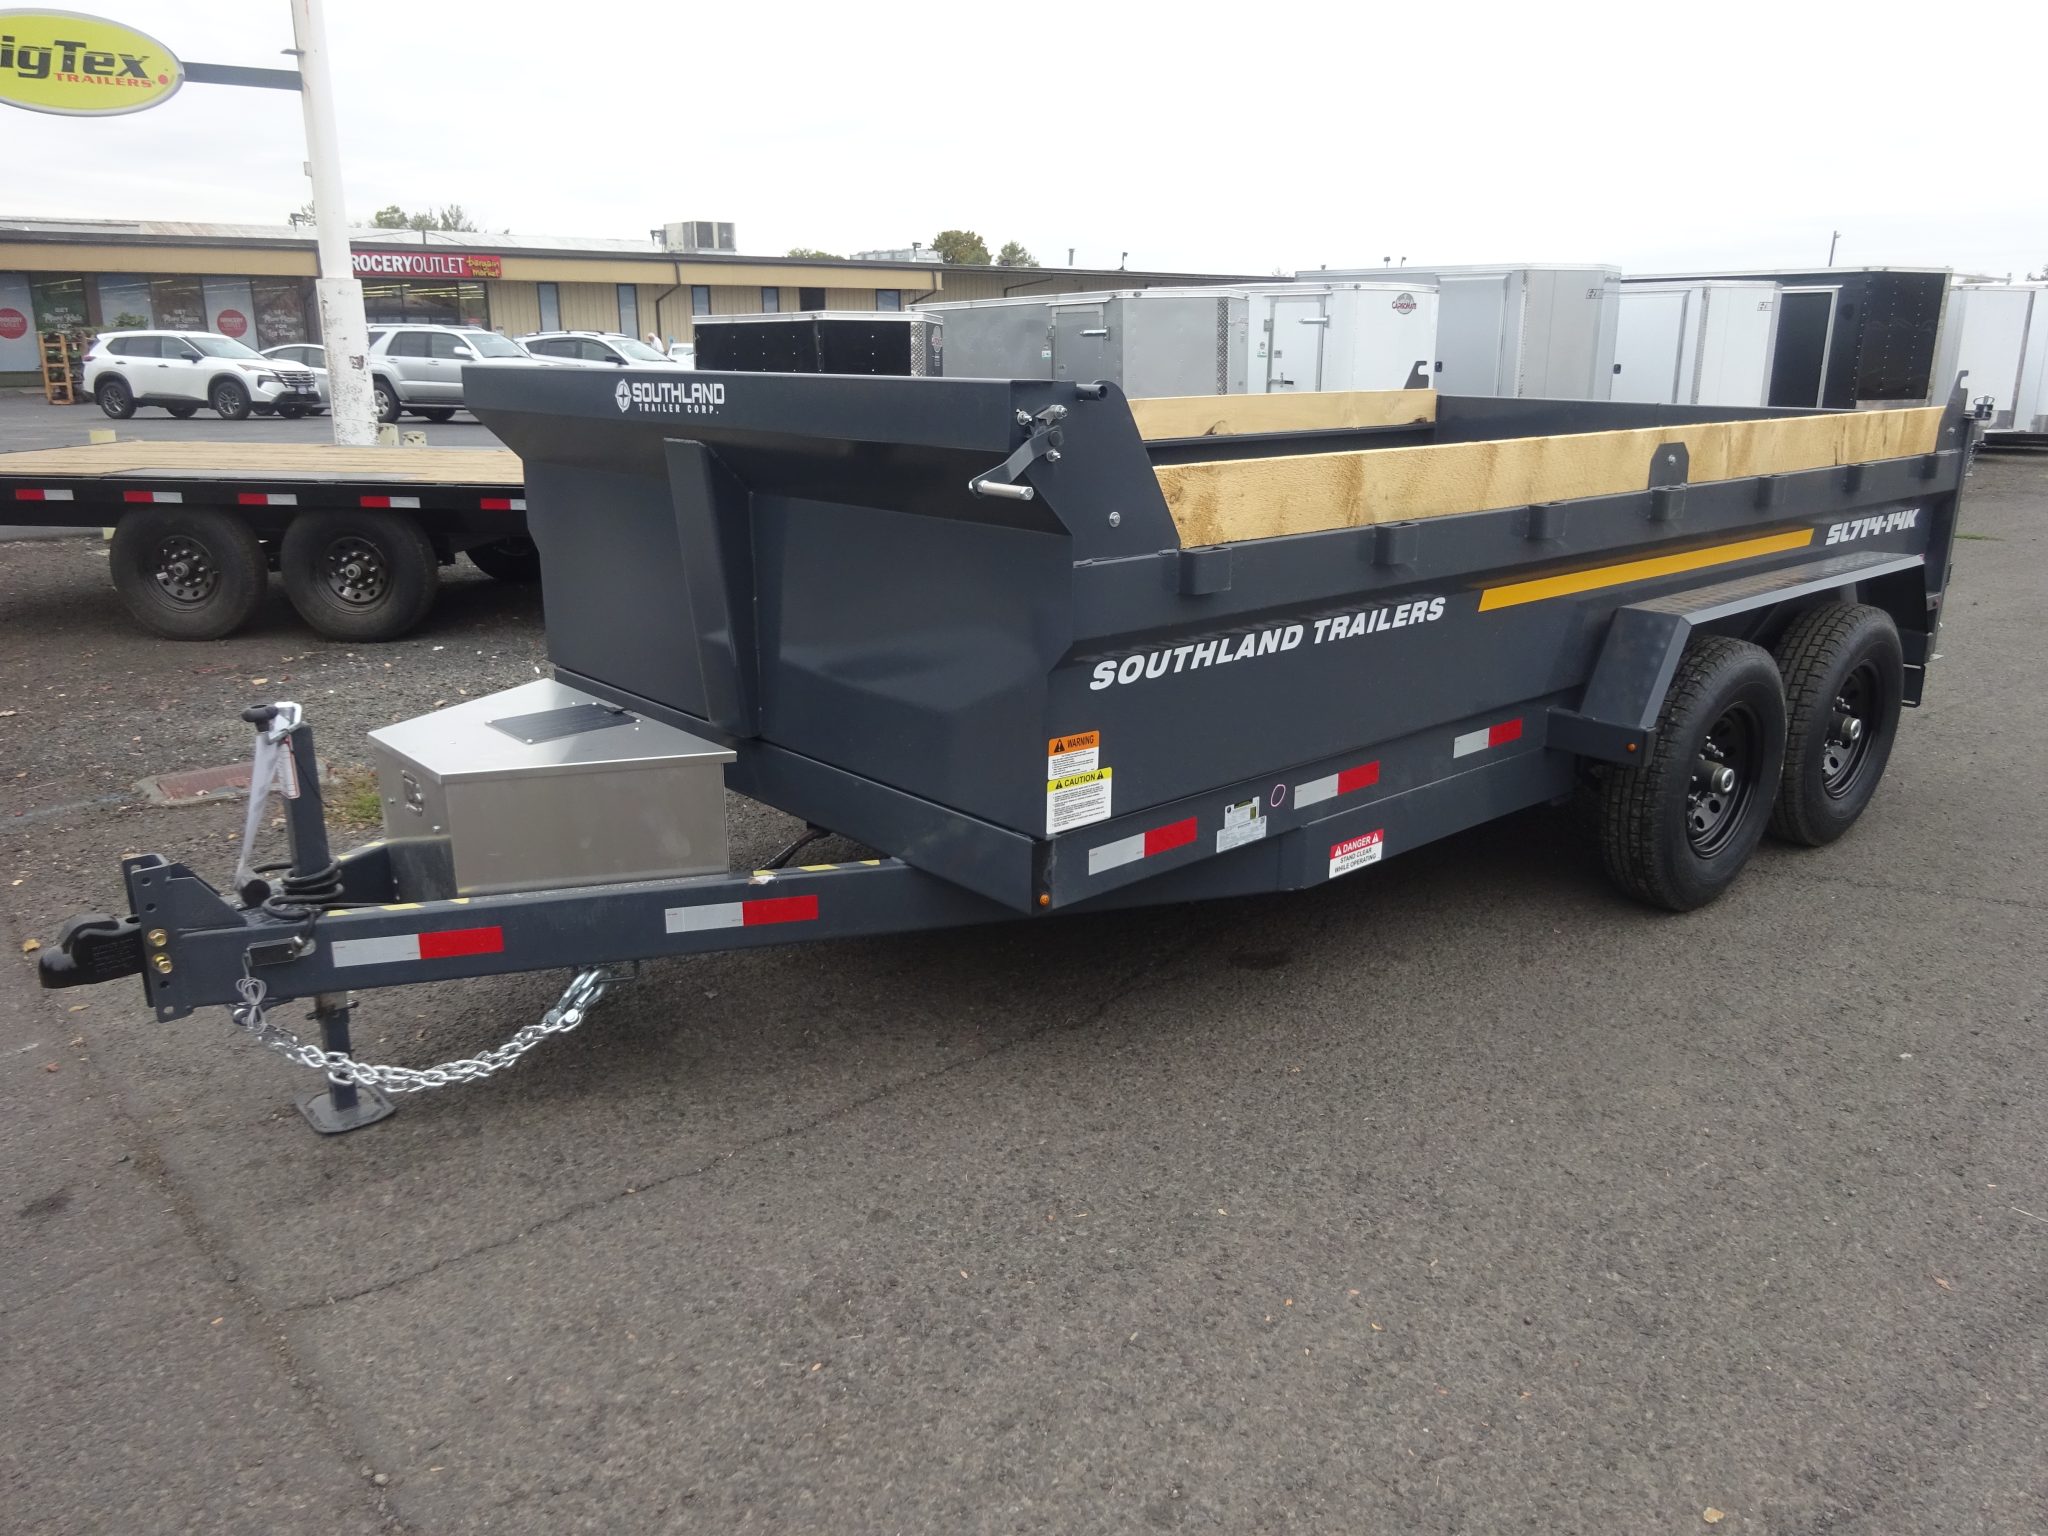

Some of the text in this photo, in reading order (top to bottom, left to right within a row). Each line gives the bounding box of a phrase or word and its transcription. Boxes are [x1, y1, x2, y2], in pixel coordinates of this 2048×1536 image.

[0, 36, 149, 79] igTex
[54, 73, 152, 88] TRAILERS
[632, 383, 725, 404] SOUTHLAND
[639, 403, 719, 414] TRAILER CORP.
[1825, 508, 1920, 546] SL714-14K
[1089, 597, 1446, 690] SOUTHLAND TRAILERS
[1067, 734, 1094, 748] WARNING
[1064, 773, 1096, 787] CAUTION
[1342, 835, 1371, 854] DANGER
[1334, 853, 1376, 873] WHILE OPERATING
[1340, 847, 1372, 863] STAND CLEAR
